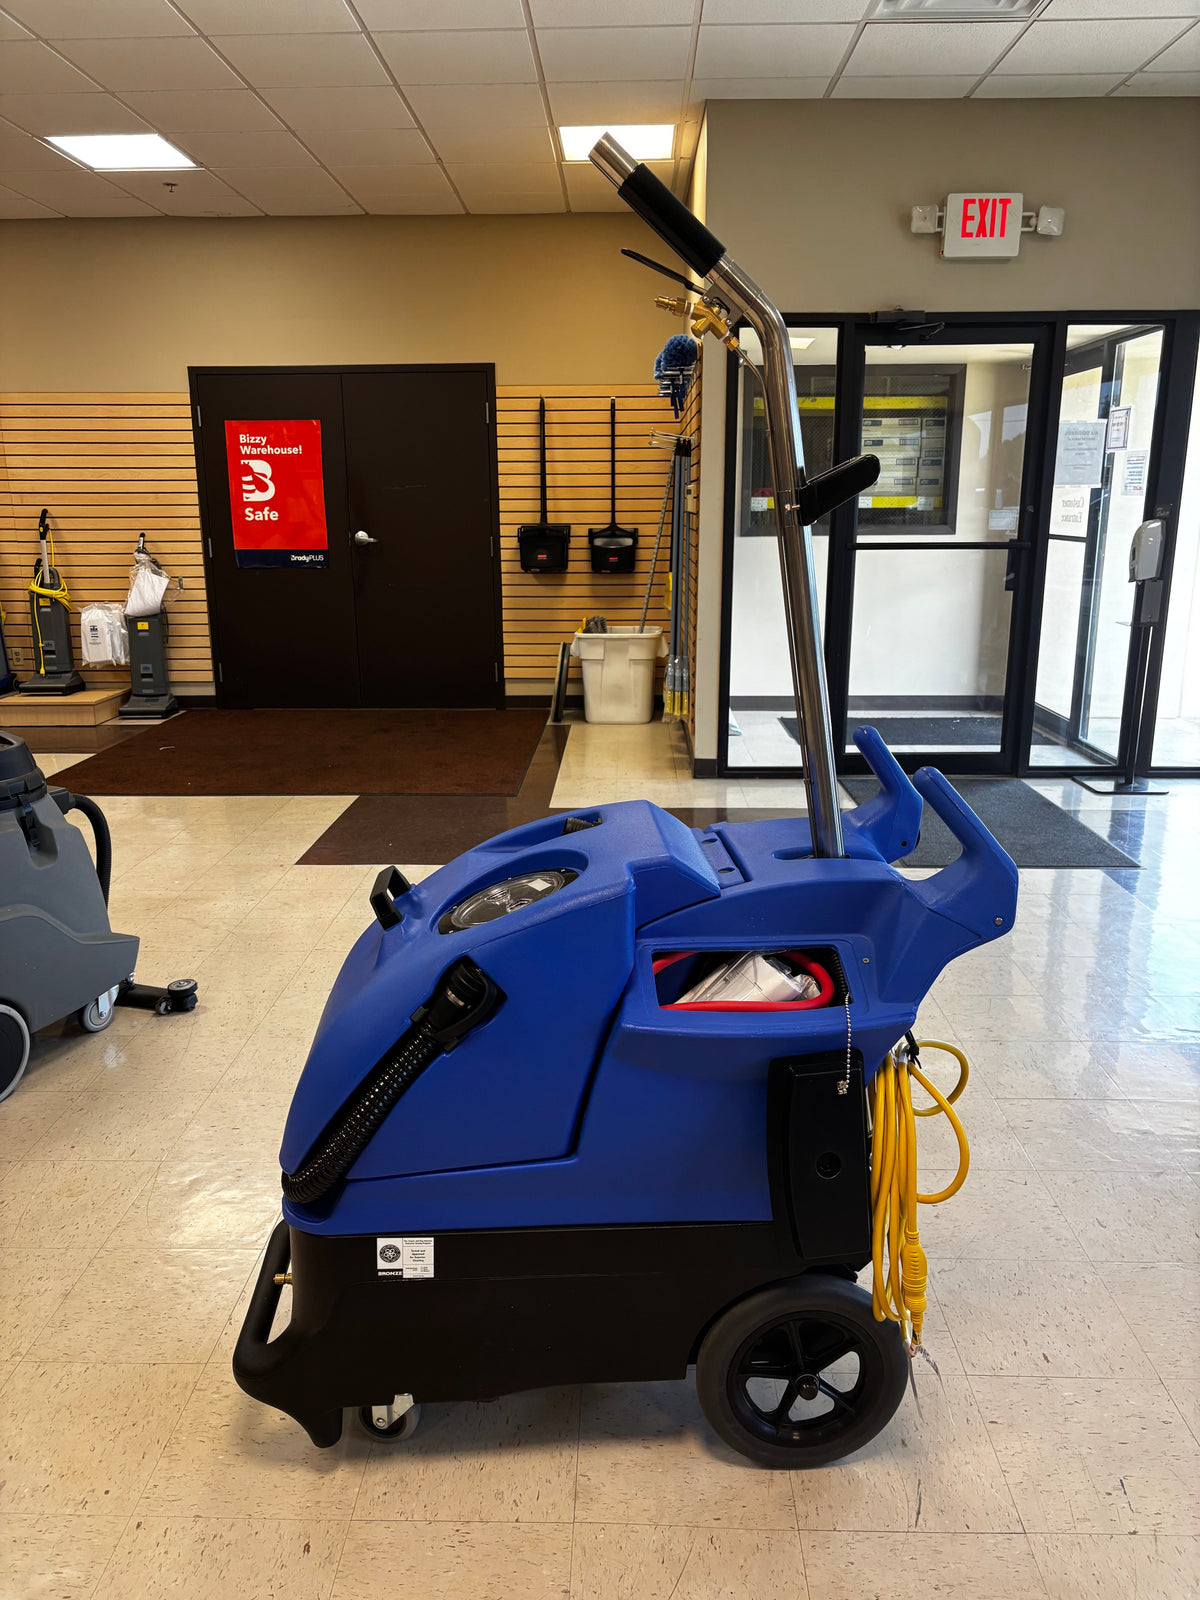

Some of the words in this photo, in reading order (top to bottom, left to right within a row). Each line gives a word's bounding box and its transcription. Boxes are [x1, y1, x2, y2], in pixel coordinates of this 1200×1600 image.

[960, 198, 1012, 238] EXIT
[239, 433, 267, 446] Bizzy
[240, 444, 303, 455] Warehouse!
[244, 506, 279, 521] Safe
